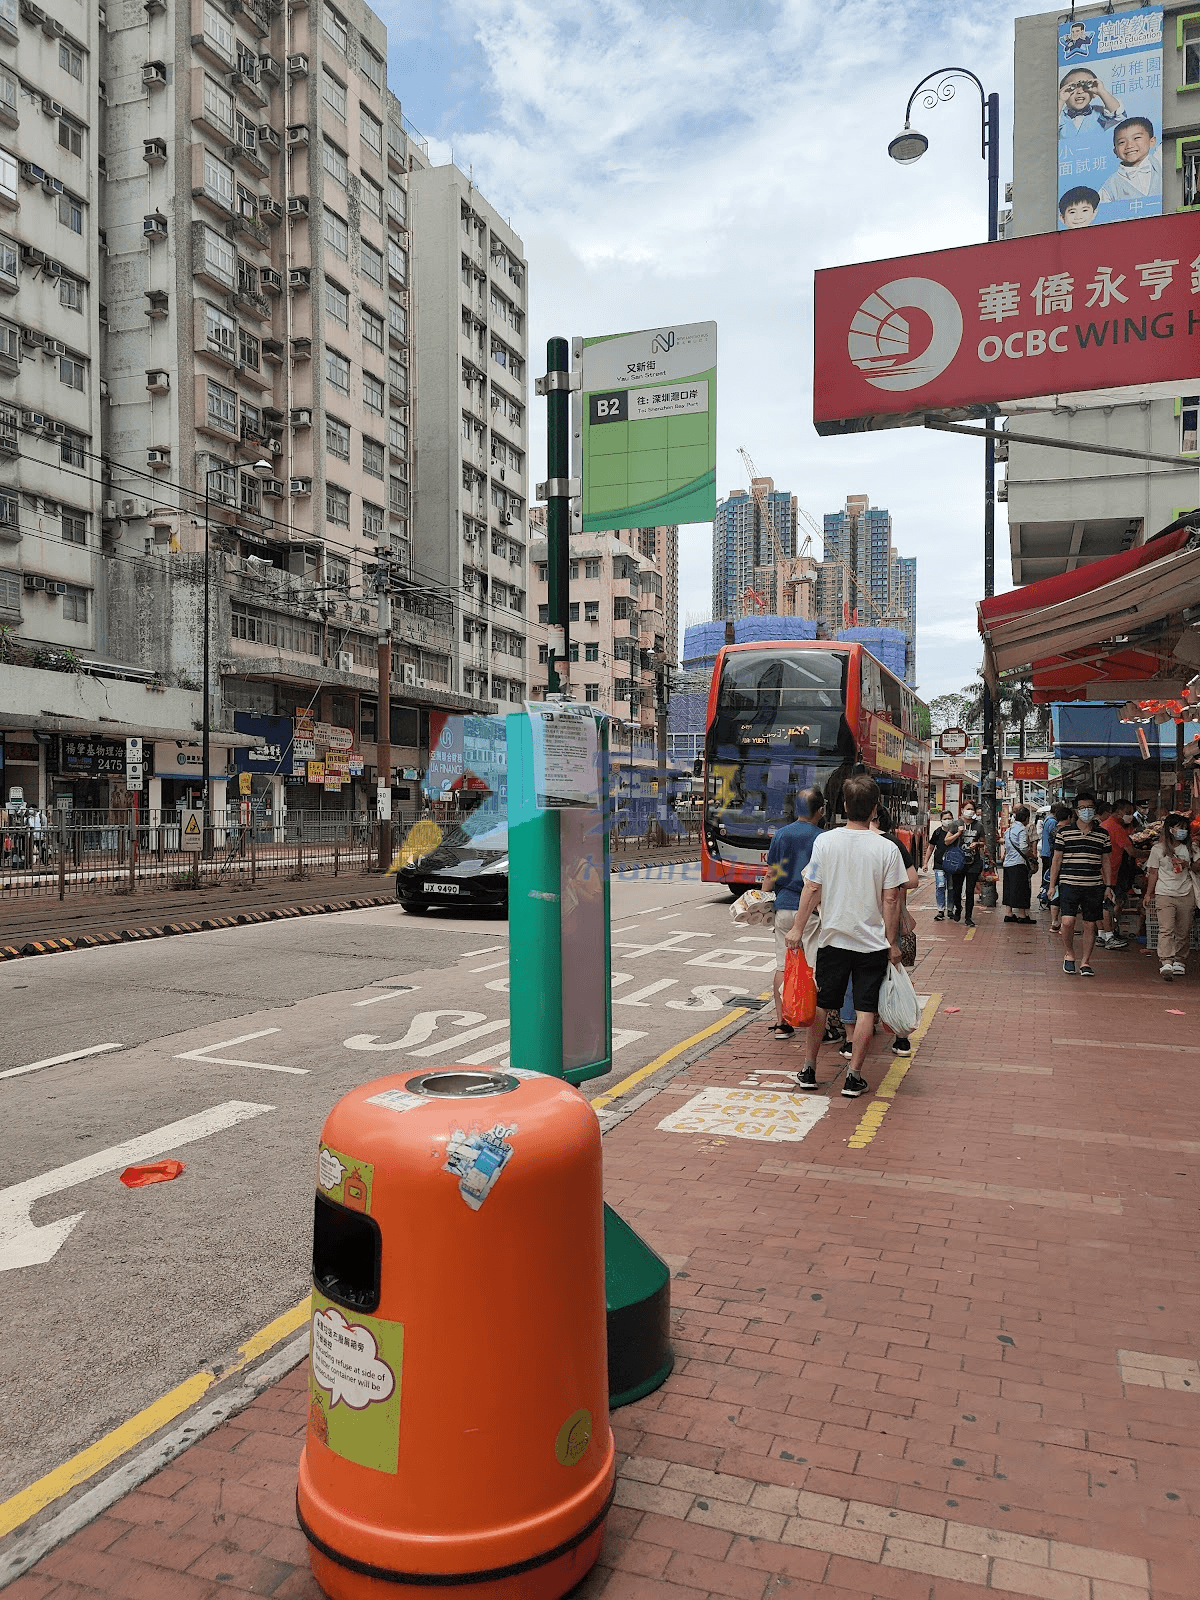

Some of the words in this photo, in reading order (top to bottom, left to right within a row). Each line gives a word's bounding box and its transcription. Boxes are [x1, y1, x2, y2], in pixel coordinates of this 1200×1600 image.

[1098, 13, 1162, 41] 梓峰教育
[1099, 38, 1123, 49] Dunn's
[1124, 31, 1161, 45] Education
[1111, 56, 1161, 79] 幼稚園
[1111, 75, 1161, 95] 面試班
[1059, 146, 1090, 159] 小一
[1059, 155, 1108, 177] 面試班
[1129, 198, 1161, 215] 中一
[977, 325, 1069, 363] OCBC
[1075, 311, 1174, 349] WING
[627, 360, 656, 374] 又新街
[597, 398, 620, 417] B2
[65, 742, 151, 758] 楊肇基物理治心
[97, 758, 123, 771] 2475
[430, 763, 438, 773] UA
[439, 763, 463, 775] FINANCE
[437, 885, 458, 893] 9490
[672, 1117, 800, 1136] 276P
[330, 1365, 356, 1384] container
[357, 1377, 370, 1388] will
[371, 1382, 381, 1392] be
[335, 1358, 353, 1372] refuse
[353, 1366, 360, 1375] at
[361, 1369, 376, 1379] side
[377, 1373, 386, 1381] of
